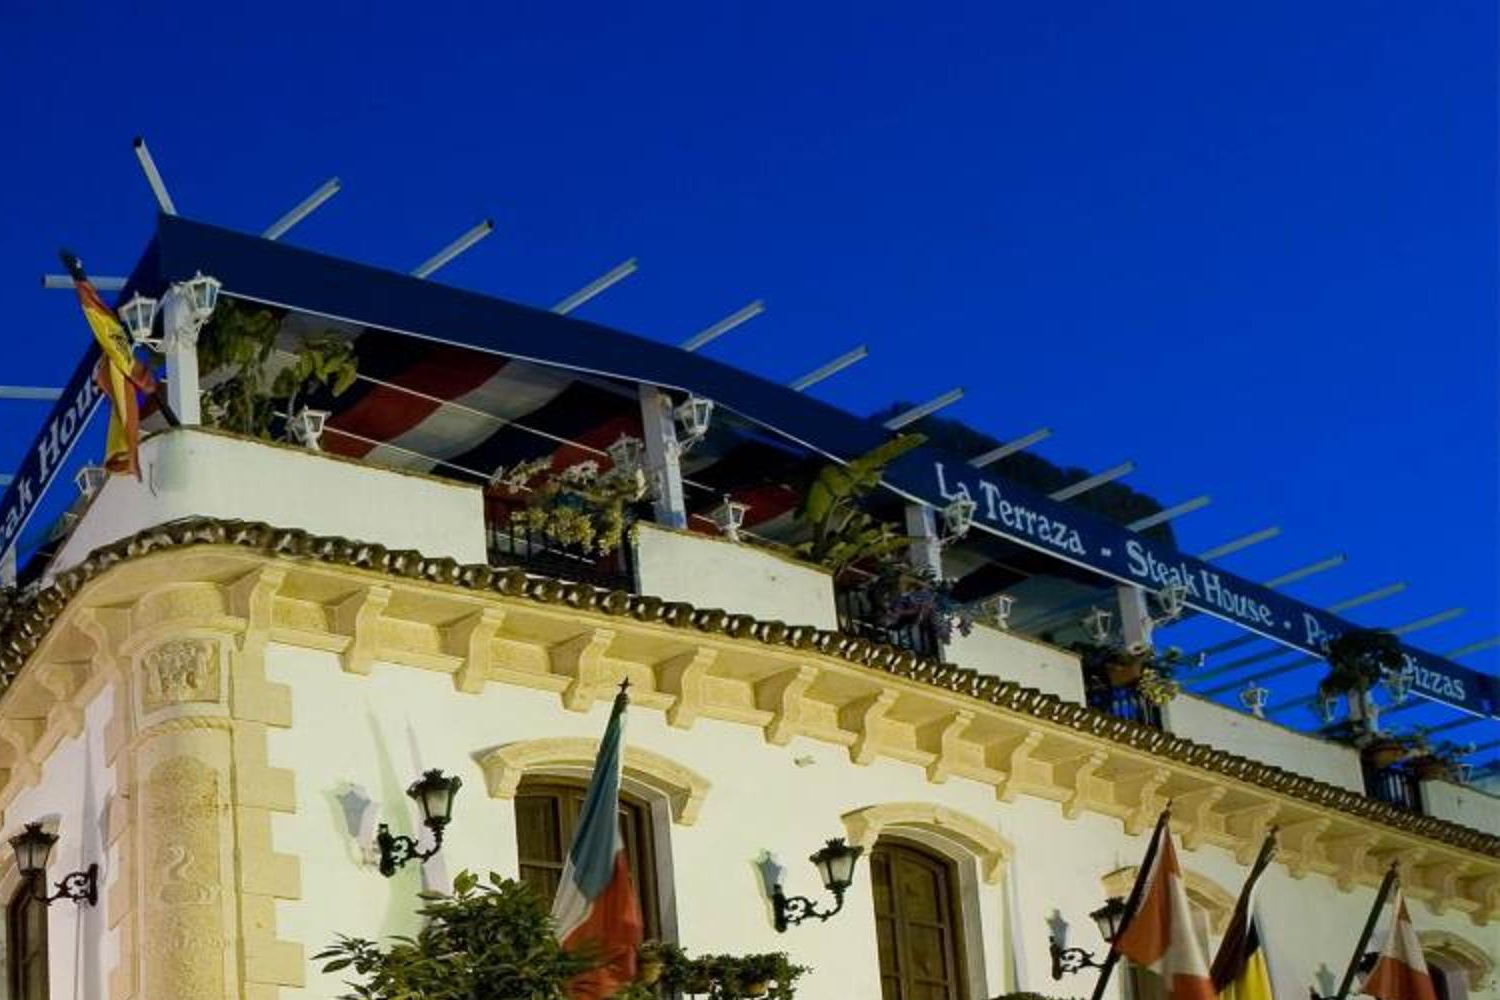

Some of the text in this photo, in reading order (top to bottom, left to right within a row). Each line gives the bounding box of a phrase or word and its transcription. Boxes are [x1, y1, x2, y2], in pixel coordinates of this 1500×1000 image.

[37, 355, 104, 483] Hous
[934, 461, 971, 503] La
[979, 479, 1087, 556] Terraza
[1125, 540, 1200, 597] Steak
[1200, 569, 1275, 627] House
